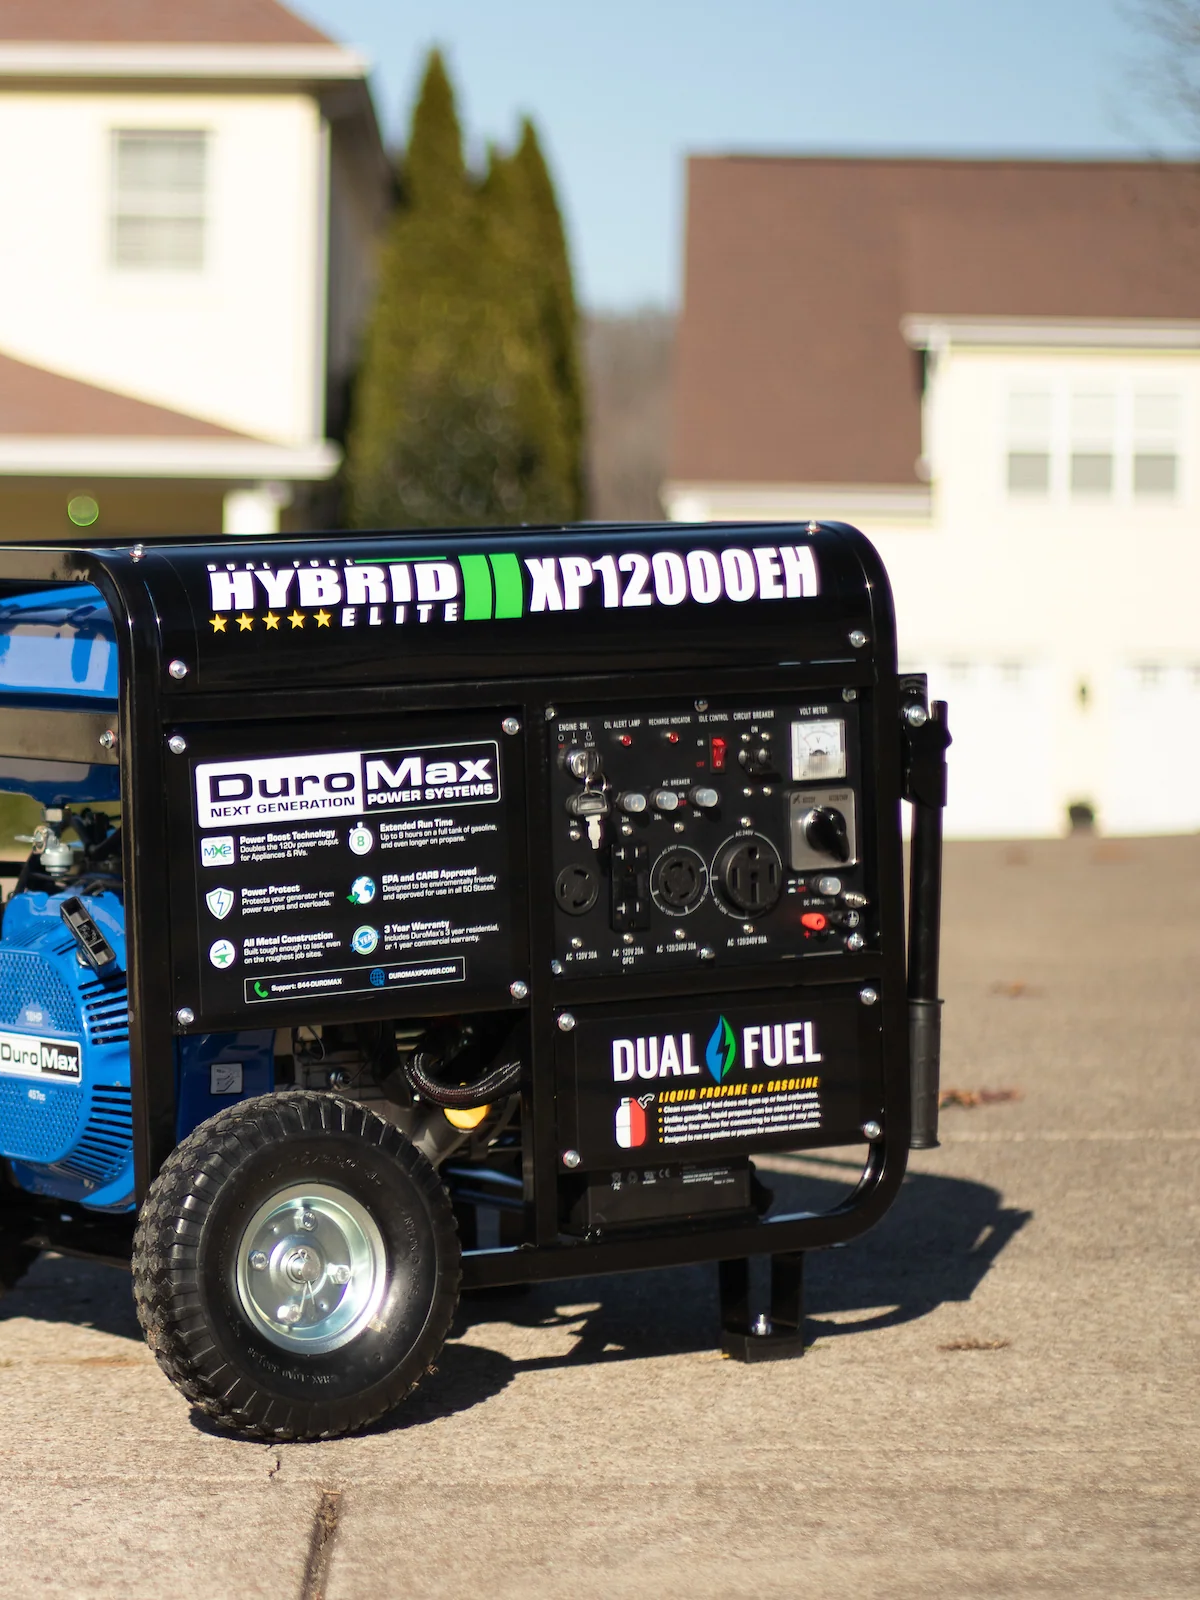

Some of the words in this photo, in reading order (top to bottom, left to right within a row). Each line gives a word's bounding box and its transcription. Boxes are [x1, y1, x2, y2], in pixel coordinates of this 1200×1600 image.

[207, 562, 270, 571] DUAL
[294, 558, 354, 568] FUEL
[209, 562, 458, 612] HYBRID
[524, 546, 818, 612] XP12000EH
[342, 603, 458, 628] ELITE
[733, 712, 751, 720] CIRCUIT
[753, 711, 774, 719] BREAKER
[799, 708, 811, 716] VOLT
[813, 706, 828, 714] METER
[613, 720, 628, 728] ALERT
[629, 719, 640, 727] LAMP
[649, 718, 669, 726] RECHARGE
[671, 716, 691, 724] INDICATOR
[709, 714, 729, 722] CONTROL
[559, 723, 577, 731] ENGINE
[579, 722, 589, 730] SW.
[210, 806, 250, 818] NEXT
[257, 796, 355, 814] GENERATION
[367, 790, 421, 806] POWER
[425, 784, 494, 800] SYSTEMS
[380, 822, 416, 832] Extended
[418, 820, 433, 829] Run
[434, 818, 453, 827] Time
[240, 835, 265, 845] Power
[267, 832, 291, 842] Boost
[292, 830, 335, 840] Technology
[381, 833, 390, 842] Up
[405, 830, 423, 838] hours
[438, 827, 448, 835] full
[449, 826, 462, 834] tank
[464, 825, 470, 833] of
[471, 824, 497, 834] gasoline,
[240, 844, 266, 853] Doubles
[280, 842, 296, 850] 120v
[297, 841, 316, 849] power
[357, 836, 364, 846] 8
[409, 838, 428, 847] longer
[439, 836, 465, 845] propane.
[251, 852, 285, 861] Appliances
[382, 875, 399, 884] EPA
[400, 873, 414, 882] and
[416, 870, 439, 880] CARB
[440, 867, 477, 879] Approved
[242, 888, 267, 897] Power
[269, 885, 300, 895] Protect
[382, 884, 411, 893] Designed
[429, 878, 473, 888] enviromentally
[474, 876, 496, 884] friendly
[396, 890, 424, 900] approved
[463, 885, 472, 893] 50
[473, 884, 495, 892] States.
[242, 897, 270, 906] Protects
[272, 896, 285, 904] your
[287, 893, 318, 902] generator
[242, 907, 262, 915] power
[263, 904, 285, 912] surges
[300, 900, 330, 908] overloads.
[384, 925, 390, 934] 3
[392, 924, 410, 933] Year
[411, 920, 450, 931] Warranty
[384, 932, 409, 942] Includes
[410, 929, 444, 939] DuroMax's
[451, 928, 464, 936] year
[466, 924, 499, 933] residential,
[244, 938, 254, 947] All
[256, 936, 280, 946] Metal
[281, 932, 333, 943] Construction
[399, 942, 413, 950] year
[414, 938, 450, 947] commercial
[451, 934, 479, 943] warranty.
[727, 939, 734, 947] AC
[244, 948, 258, 956] Built
[260, 946, 278, 955] tough
[279, 945, 302, 953] enough
[612, 949, 619, 957] AC
[656, 945, 663, 953] AC
[266, 952, 294, 962] roughest
[295, 952, 304, 960] job
[566, 953, 572, 961] AC
[622, 957, 634, 965] GFCI
[389, 966, 456, 980] DUROMAXPOWER.COM
[271, 984, 296, 992] Support:
[297, 978, 342, 989] 844-DUROMAX
[612, 1032, 700, 1082] DUAL
[743, 1020, 822, 1069] FUEL
[659, 1088, 696, 1103] LIQUID
[700, 1083, 748, 1099] PROPANE
[751, 1084, 763, 1094] or
[767, 1076, 818, 1092] GASOLINE
